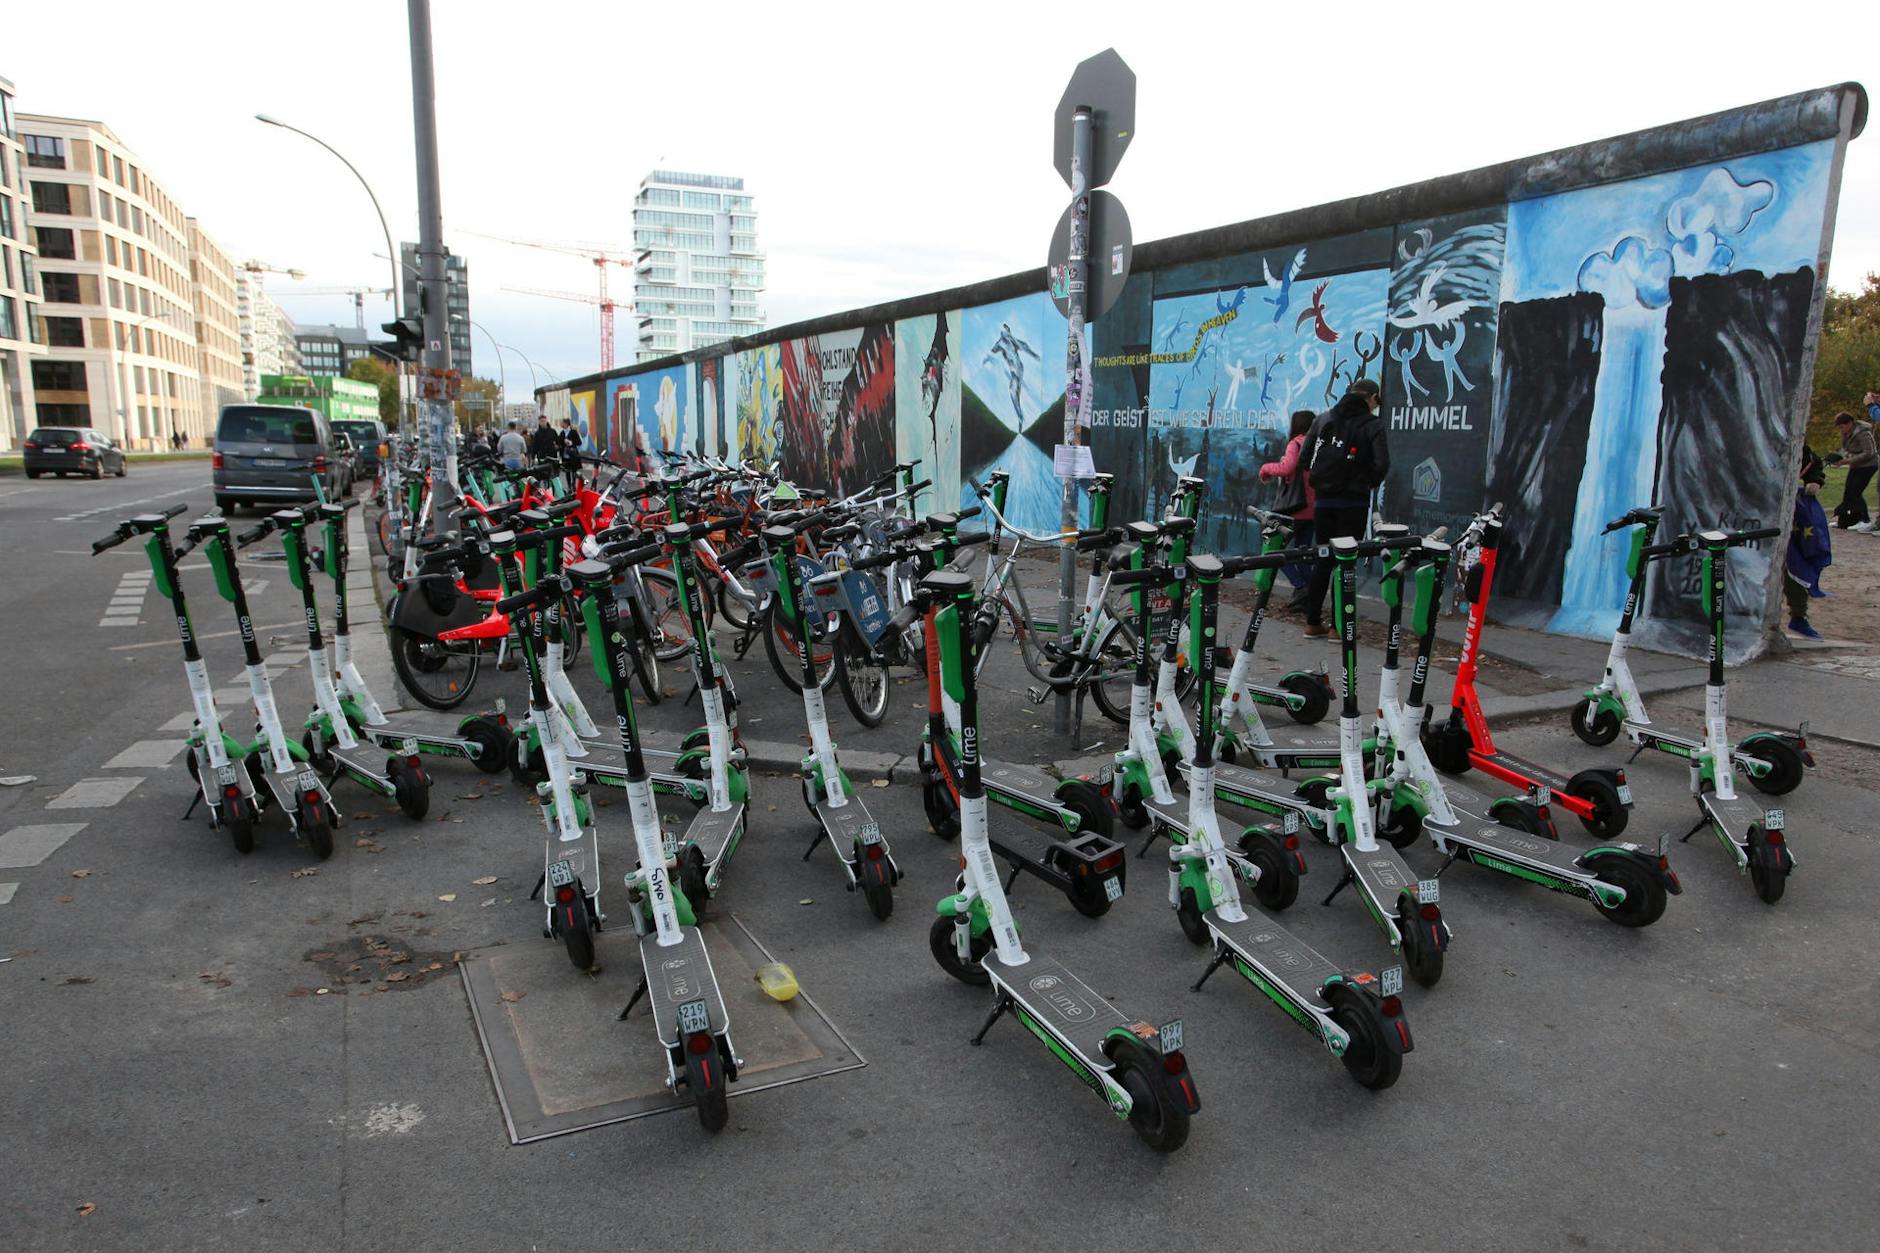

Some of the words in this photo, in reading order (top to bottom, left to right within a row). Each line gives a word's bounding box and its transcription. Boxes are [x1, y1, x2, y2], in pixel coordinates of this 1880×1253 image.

[1092, 410, 1109, 426] DER
[1113, 406, 1144, 428] GEIST
[1391, 405, 1472, 431] HIMMEL
[177, 616, 191, 642] Lime
[240, 615, 255, 642] Lime
[306, 607, 317, 633] Lime
[534, 611, 542, 637] Lime
[1168, 618, 1180, 645] Lime
[1250, 607, 1265, 634] Lime
[1346, 620, 1354, 641] Lime
[1388, 623, 1400, 650] Lime
[1136, 635, 1145, 665] Lime
[616, 651, 627, 678] Lime
[1413, 655, 1428, 684] Lime
[617, 714, 632, 753] Lime
[962, 726, 977, 765] Lime
[1488, 858, 1512, 873] Lime
[1420, 881, 1436, 892] 385
[1420, 891, 1438, 902] WUG
[1383, 968, 1400, 982] 927
[682, 1002, 704, 1019] 219
[1050, 990, 1083, 1017] Lime
[684, 1014, 707, 1032] WPN
[1162, 1022, 1180, 1039] 997
[1162, 1034, 1182, 1052] WPK
